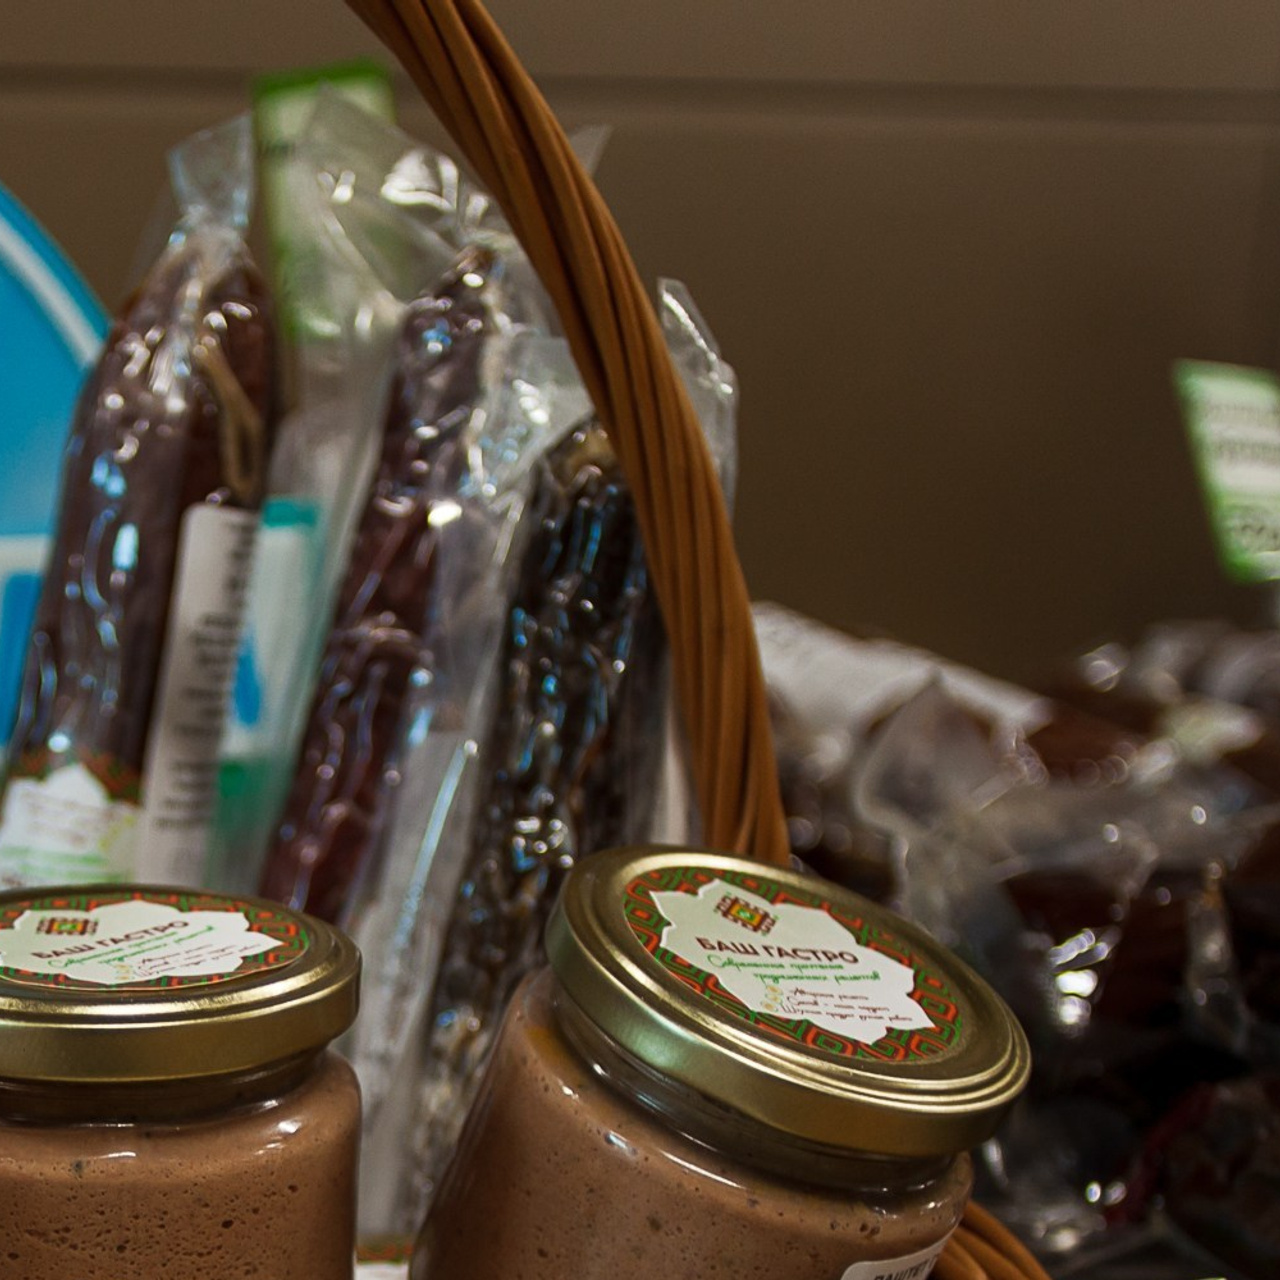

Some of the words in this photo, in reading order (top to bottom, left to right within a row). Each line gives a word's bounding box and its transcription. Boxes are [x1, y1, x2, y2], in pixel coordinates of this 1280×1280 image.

[31, 944, 96, 959] БАШ
[96, 921, 189, 947] ГАСТРО
[695, 936, 760, 956] БАШ
[761, 945, 859, 964] ГАСТРО
